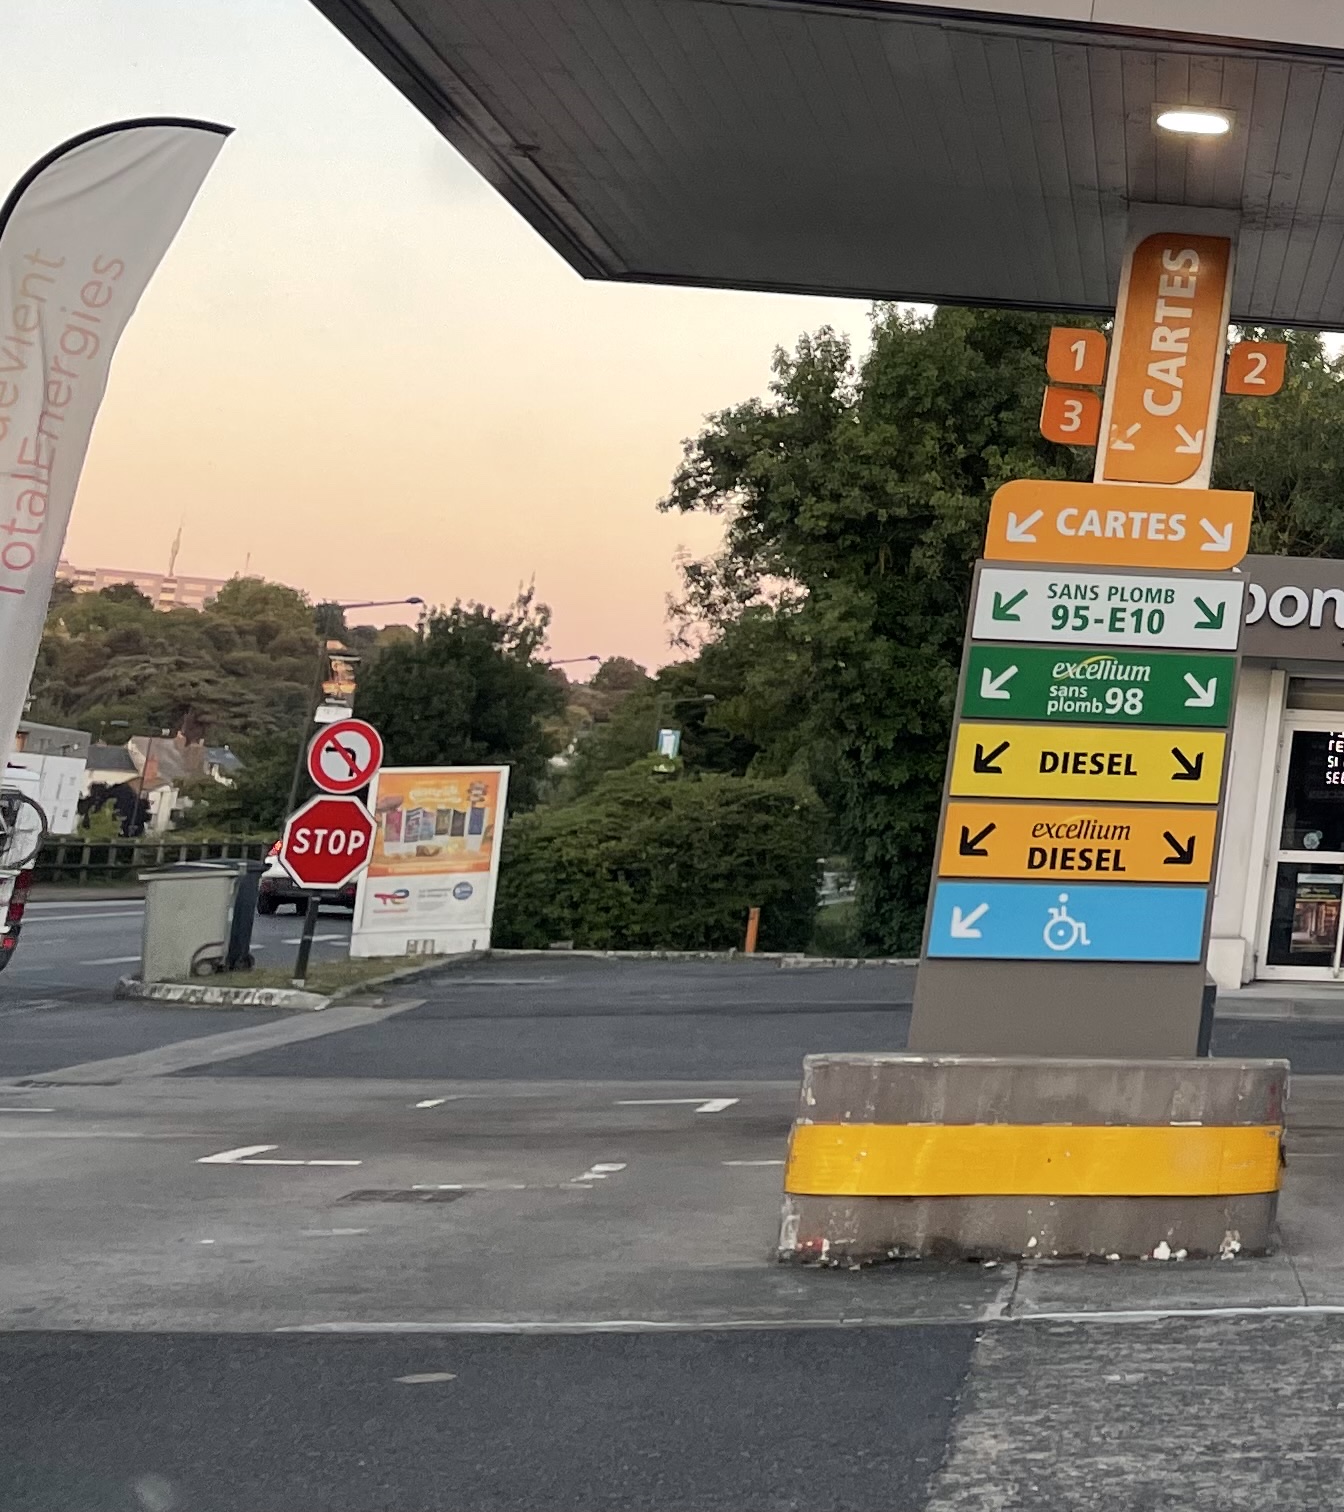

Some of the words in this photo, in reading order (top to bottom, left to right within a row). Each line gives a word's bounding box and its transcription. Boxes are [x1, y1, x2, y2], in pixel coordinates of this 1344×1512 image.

[1143, 248, 1200, 416] CARTES
[1070, 340, 1086, 372] 1
[1243, 352, 1267, 385] 2
[1059, 400, 1083, 432] 3
[1056, 508, 1187, 541] CARTES
[1047, 583, 1099, 601] SANS
[1107, 586, 1175, 604] PLOMB
[1051, 604, 1165, 634] 95-E10
[1052, 659, 1151, 682] excellium
[1047, 698, 1102, 715] plomb
[1105, 687, 1144, 715] 98
[1049, 685, 1088, 697] sans
[1039, 751, 1137, 776] DIESEL
[292, 828, 365, 856] STOP
[1031, 819, 1131, 841] excellium
[1027, 847, 1126, 871] DIESEL
